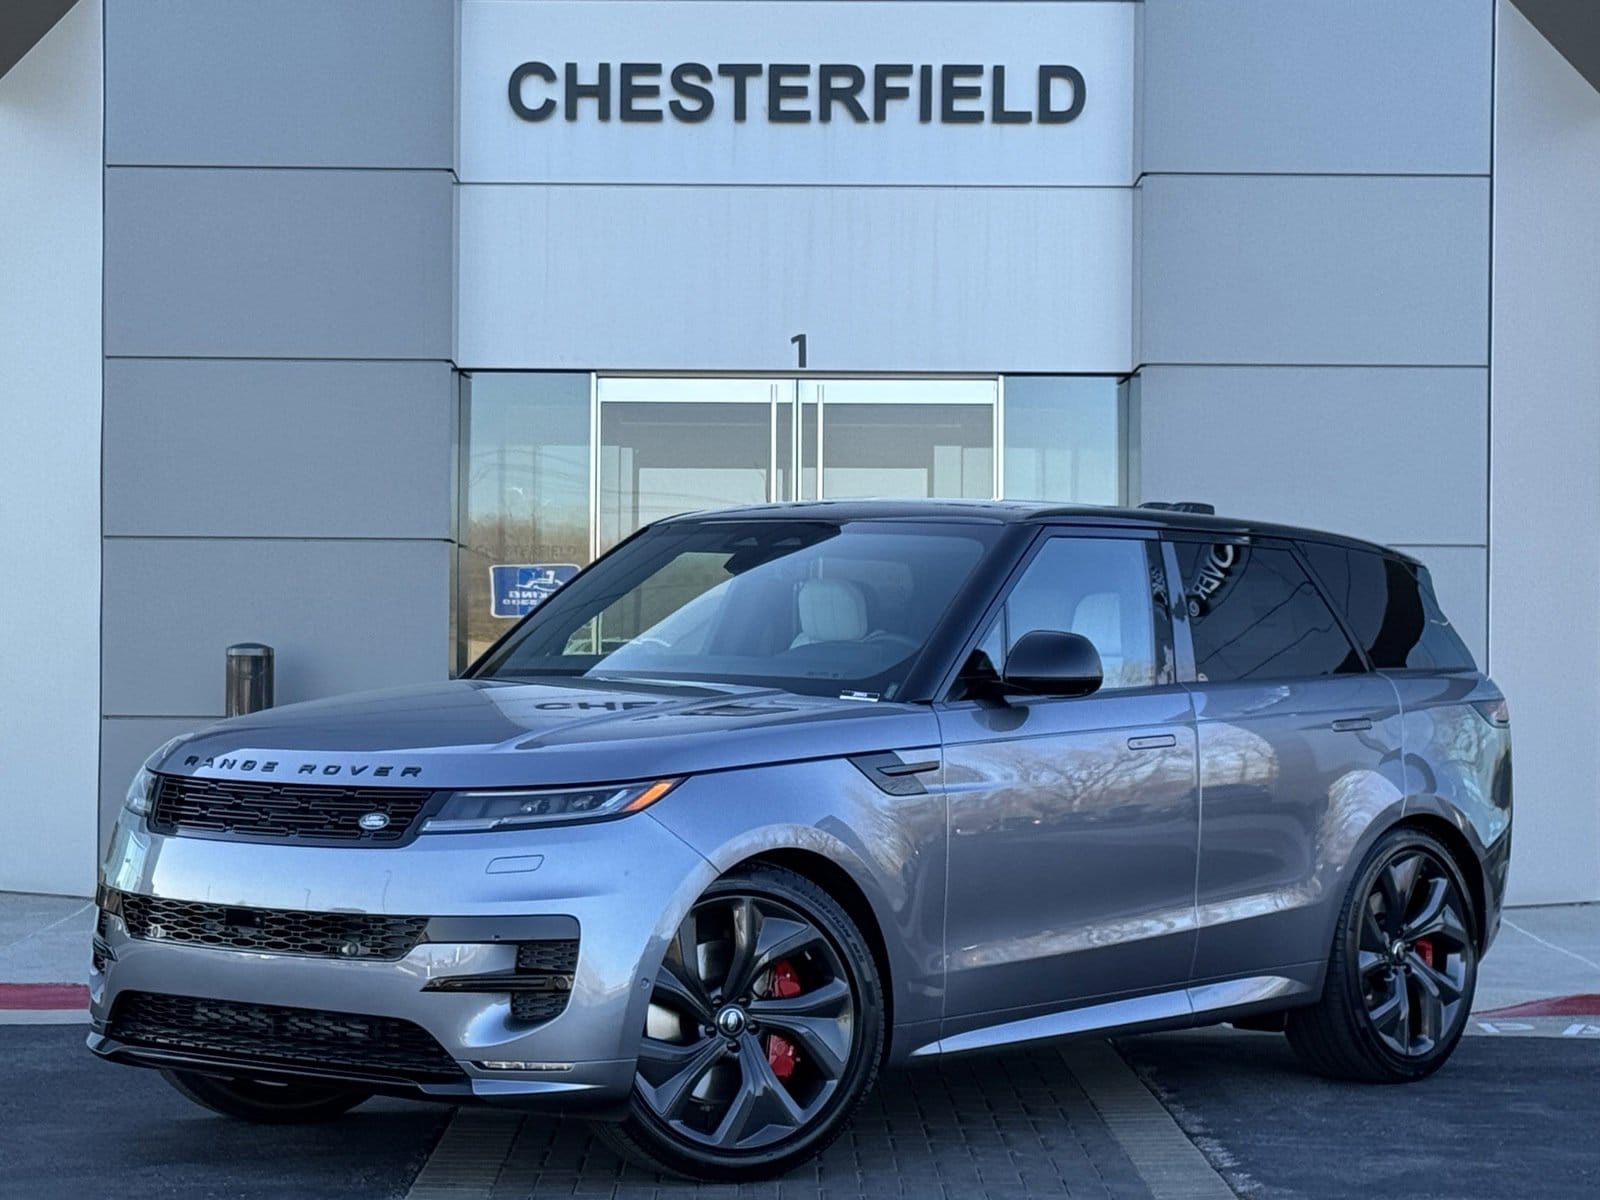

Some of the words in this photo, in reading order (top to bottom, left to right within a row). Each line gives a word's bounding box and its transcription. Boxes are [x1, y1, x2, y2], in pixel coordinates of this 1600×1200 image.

[507, 61, 1087, 125] CHESTERFIELD
[790, 333, 807, 368] 1
[184, 755, 279, 773] RANGE
[298, 764, 422, 778] ROVER
